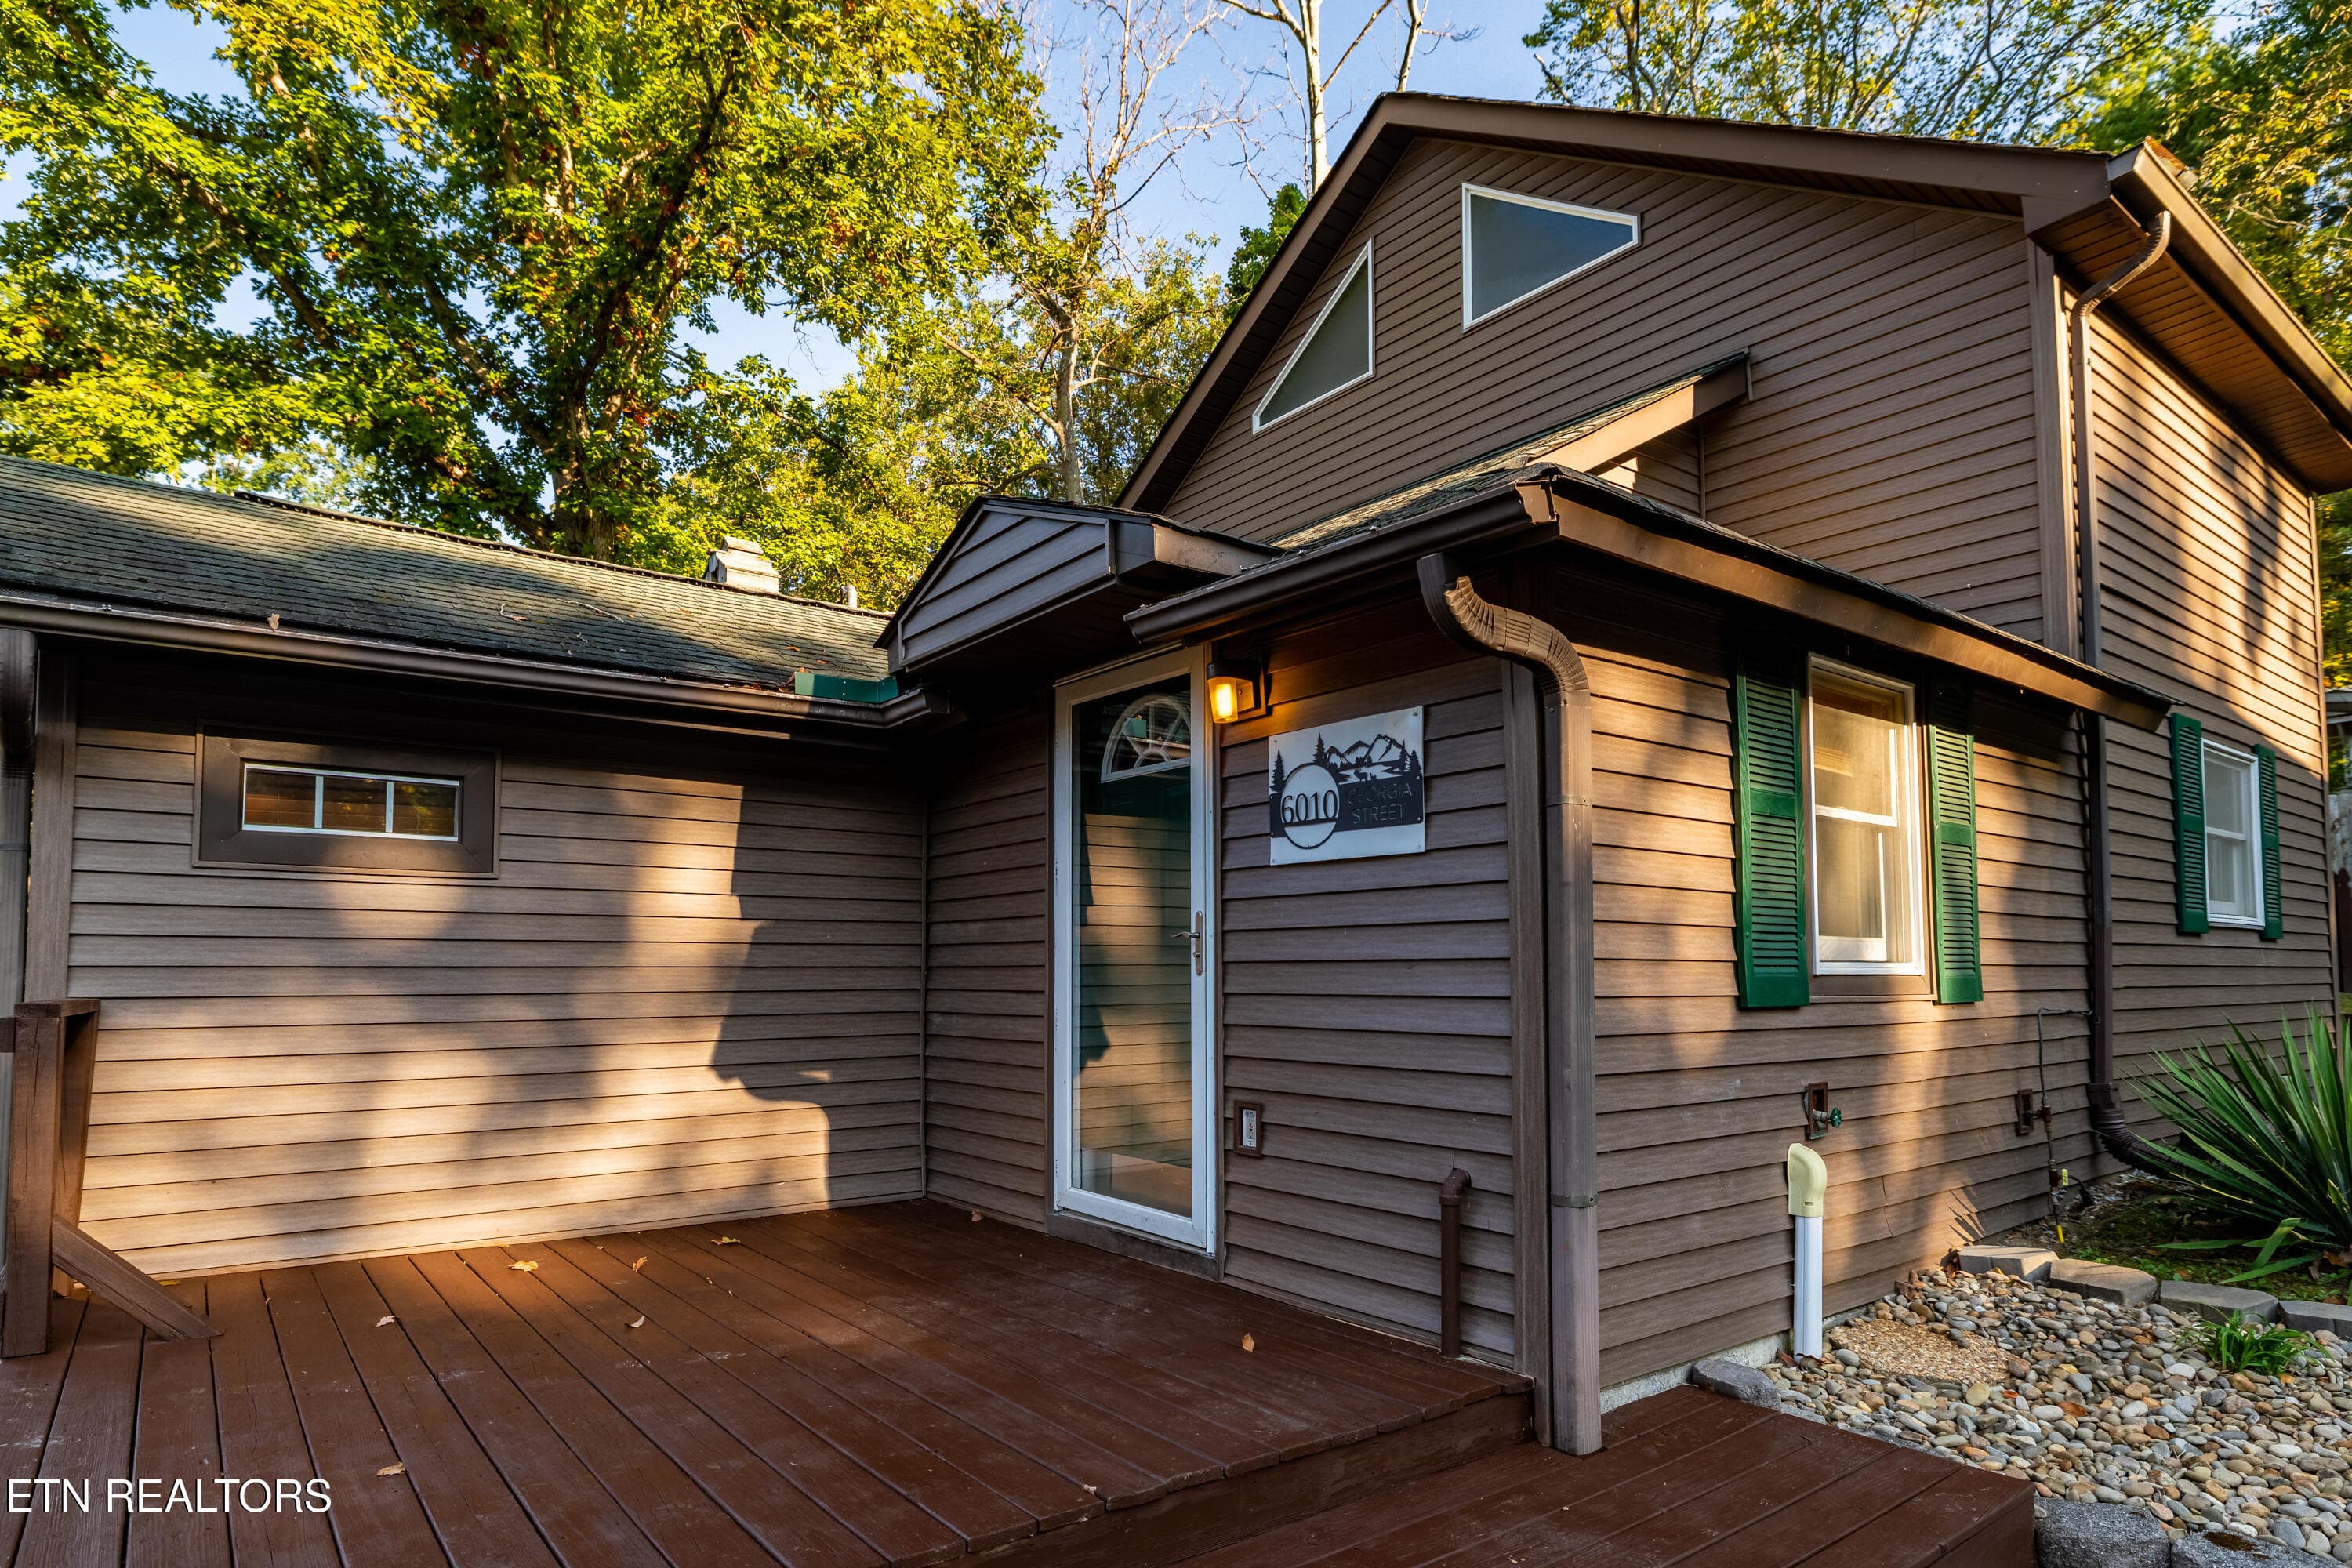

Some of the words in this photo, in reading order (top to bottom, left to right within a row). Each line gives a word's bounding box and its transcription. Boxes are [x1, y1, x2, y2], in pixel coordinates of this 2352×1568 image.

[1347, 782, 1413, 804] GEORGIA
[1282, 789, 1338, 823] 6010
[1352, 803, 1405, 823] STREET
